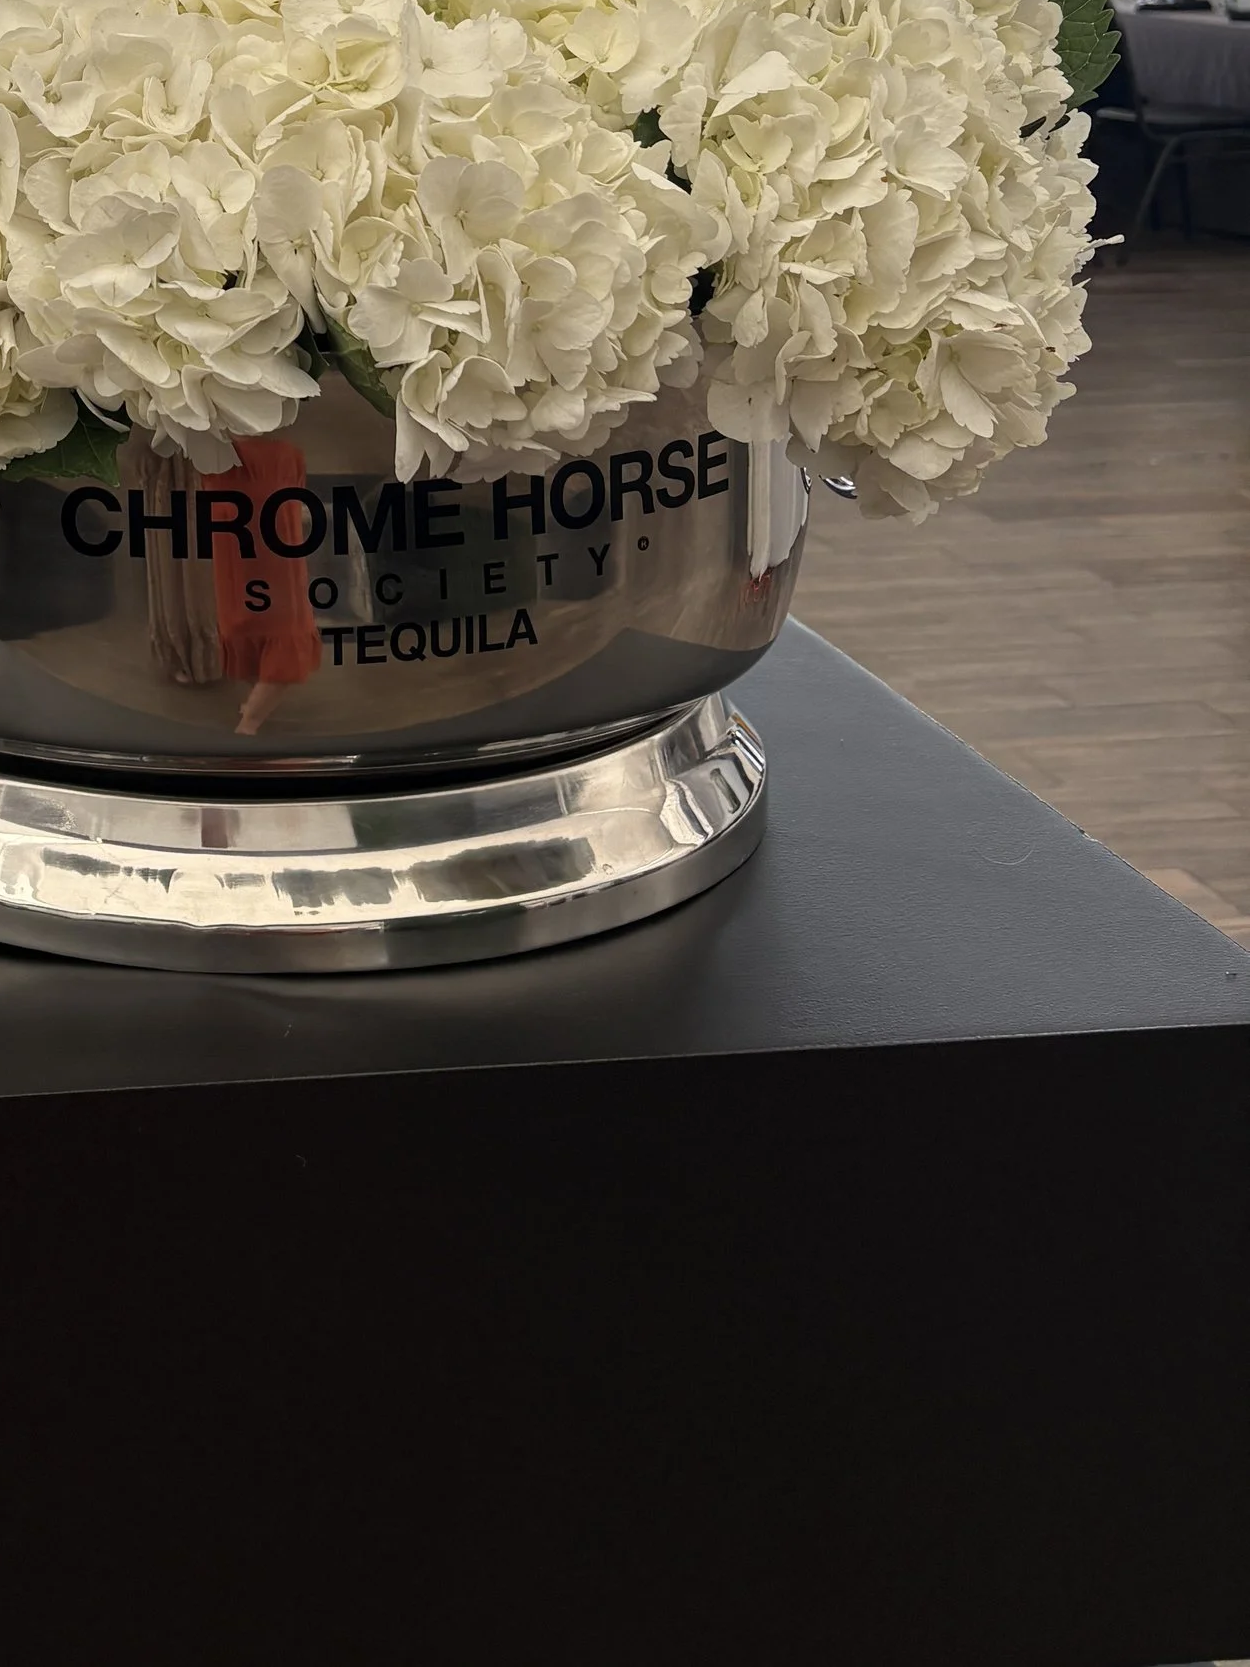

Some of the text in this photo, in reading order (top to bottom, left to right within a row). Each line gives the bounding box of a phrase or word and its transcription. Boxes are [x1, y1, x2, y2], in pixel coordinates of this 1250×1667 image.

[61, 430, 729, 560] CHROME HORSE
[244, 543, 612, 613] SOCIETY
[321, 608, 538, 666] TEQUILA
